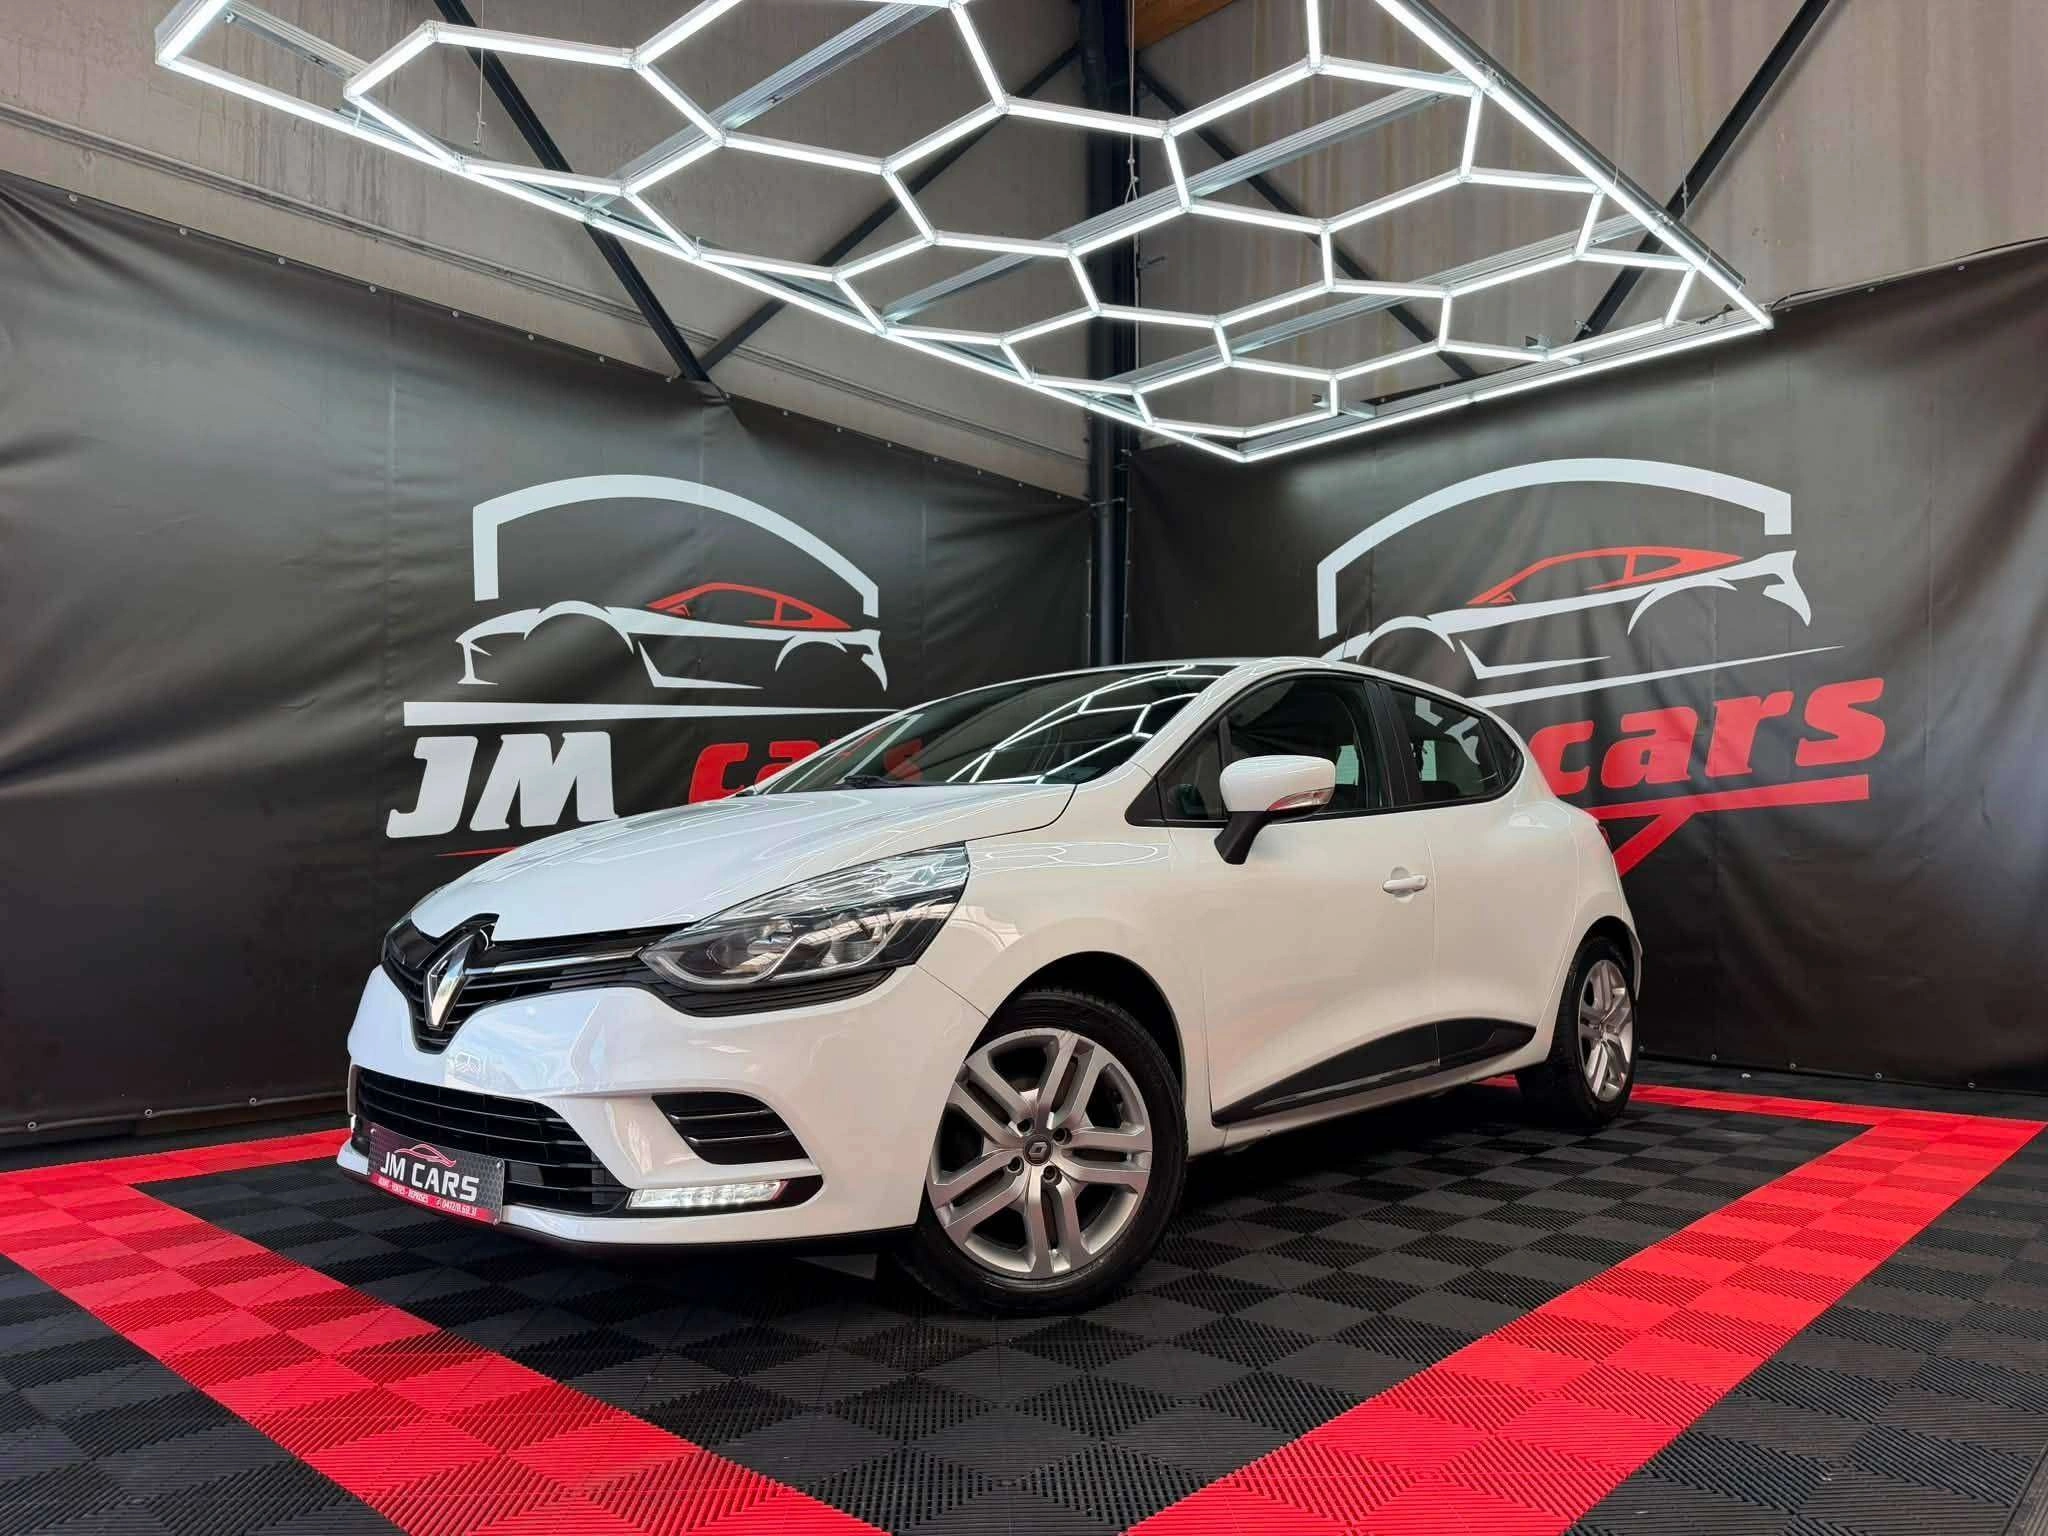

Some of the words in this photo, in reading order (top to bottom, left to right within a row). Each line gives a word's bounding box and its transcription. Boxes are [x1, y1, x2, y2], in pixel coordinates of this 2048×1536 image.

[386, 731, 620, 838] JM
[1526, 677, 1887, 796] cars
[380, 1151, 406, 1181] JM
[411, 1162, 480, 1202] CARS
